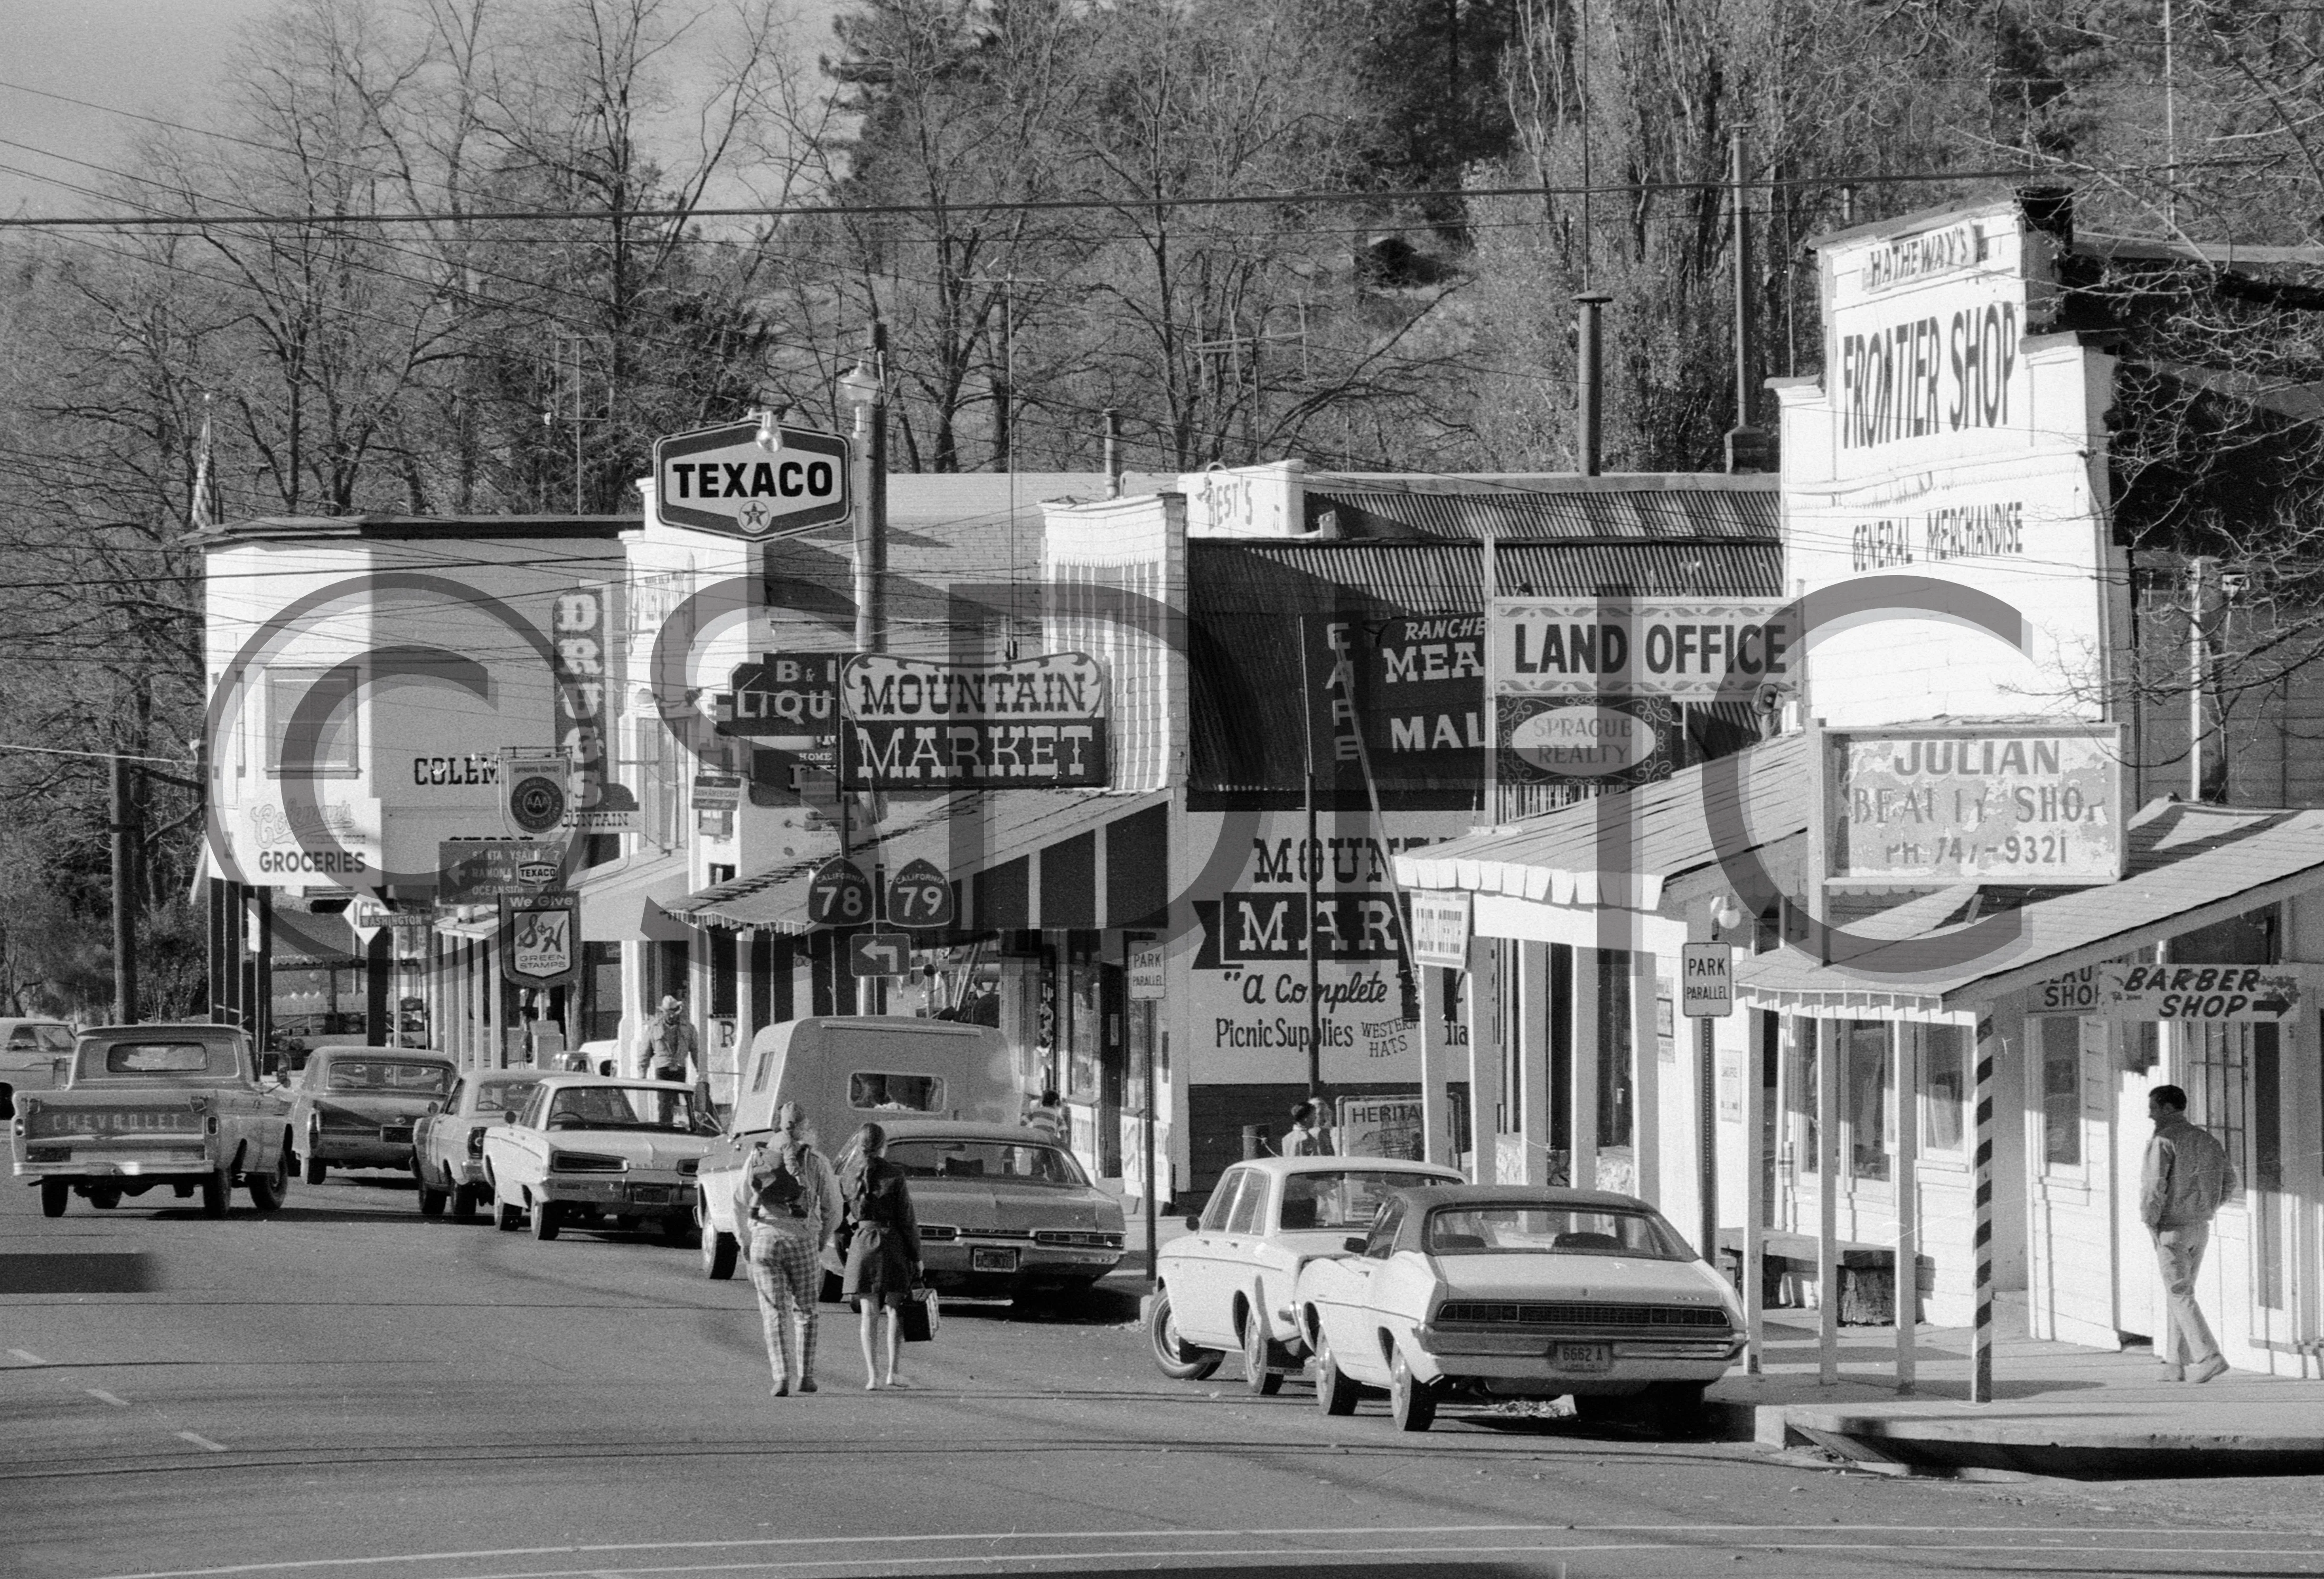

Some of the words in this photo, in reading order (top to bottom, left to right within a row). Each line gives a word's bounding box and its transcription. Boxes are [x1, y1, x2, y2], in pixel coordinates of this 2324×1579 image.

[1870, 227, 1967, 287] HATHEWAY'S
[1843, 316, 1941, 449] FRONTIER
[1950, 301, 2016, 433] SHOP
[672, 461, 833, 499] TEXACO
[1852, 517, 1913, 572] GENERAL
[1927, 502, 2023, 562] MERCHANDISE
[1515, 623, 1628, 674] LAND
[1645, 623, 1786, 674] OFFICE
[776, 660, 801, 682] B
[1382, 642, 1484, 684] MEA
[557, 594, 604, 809] DRUGS
[860, 672, 1085, 715] MOUNTAIN
[1325, 623, 1360, 760] CAFE
[737, 690, 831, 726] LIQU
[1533, 717, 1632, 739] SPRAGUE
[798, 753, 832, 761] HOME
[857, 725, 1093, 778] MARKET
[1537, 743, 1628, 765] REALTY
[1894, 740, 2060, 776] JULIAN
[528, 795, 551, 809] AAA
[259, 851, 366, 873] GROCERIES
[520, 868, 556, 877] TEXACO
[816, 872, 866, 885] CALIFORNIA
[895, 872, 945, 885] CALIFORNIA
[353, 901, 380, 925] ICE
[509, 896, 533, 908] We
[537, 896, 574, 907] Give
[817, 886, 863, 917] 78
[897, 886, 943, 917] 79
[360, 915, 422, 926] WASHINGTON
[517, 914, 566, 953] S&H
[519, 961, 566, 970] STAMPS
[1133, 953, 1161, 968] PARK
[1689, 957, 1727, 977] PARK
[1132, 975, 1164, 986] PARALLEL
[2124, 966, 2261, 992] BARBER
[1686, 985, 1729, 1000] PARALLEL
[2159, 994, 2248, 1018] SHOP
[1216, 1017, 1273, 1048] Picnic
[1276, 1017, 1354, 1053] Suplies
[1361, 1016, 1418, 1039] WESTERN
[1369, 1035, 1409, 1058] HATS
[52, 1113, 180, 1131] CHEVROLET
[1352, 1104, 1425, 1123] HERITA
